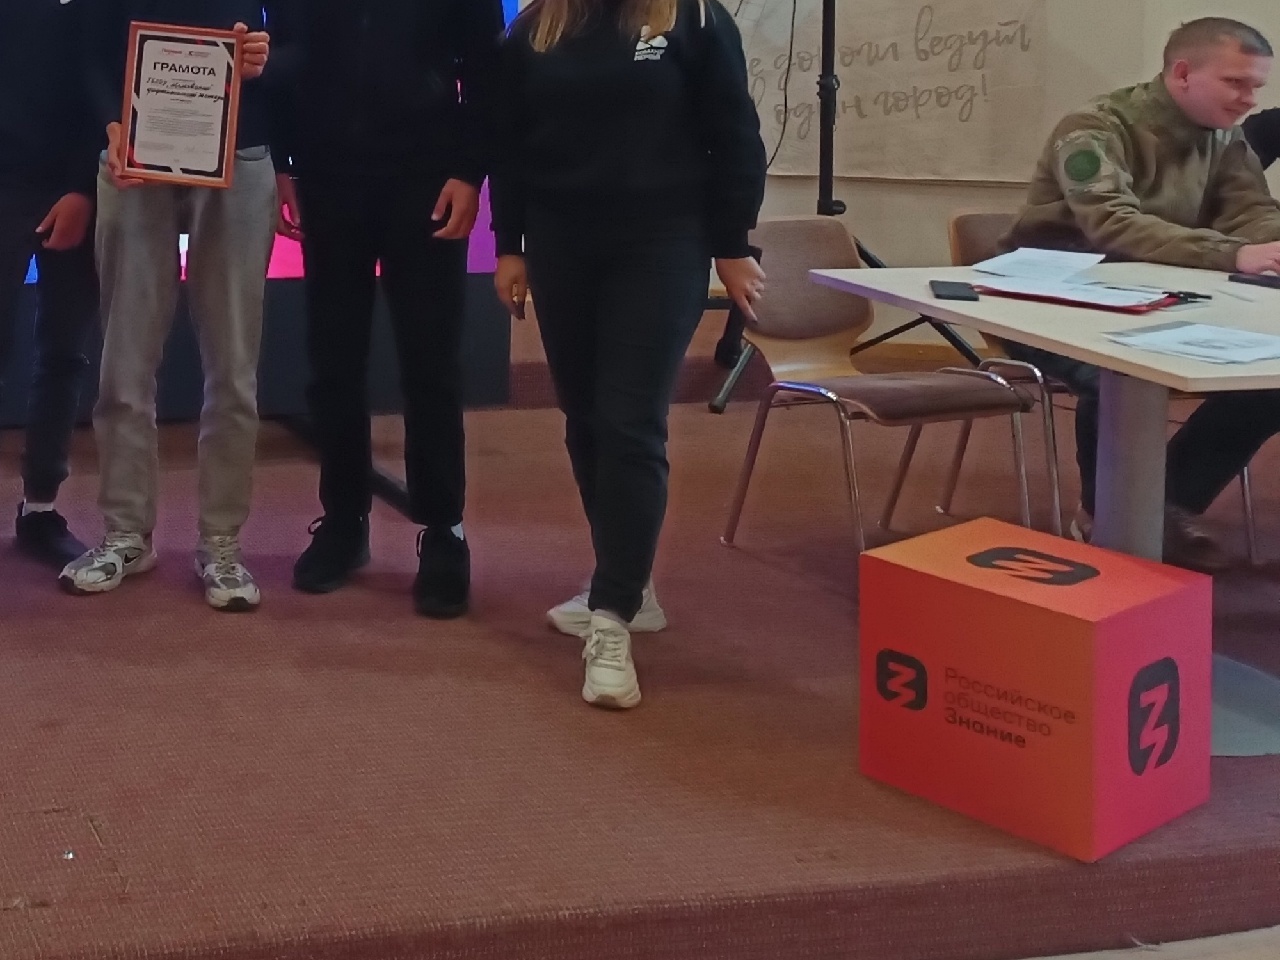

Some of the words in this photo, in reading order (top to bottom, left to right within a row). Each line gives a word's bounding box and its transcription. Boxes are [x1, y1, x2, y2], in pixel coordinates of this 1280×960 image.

[153, 61, 216, 77] ГРАМОТА
[773, 41, 900, 91] дооги
[773, 95, 868, 140] одн
[943, 690, 1052, 737] общество
[944, 666, 1076, 725] Российское
[943, 706, 1027, 749] Знание
